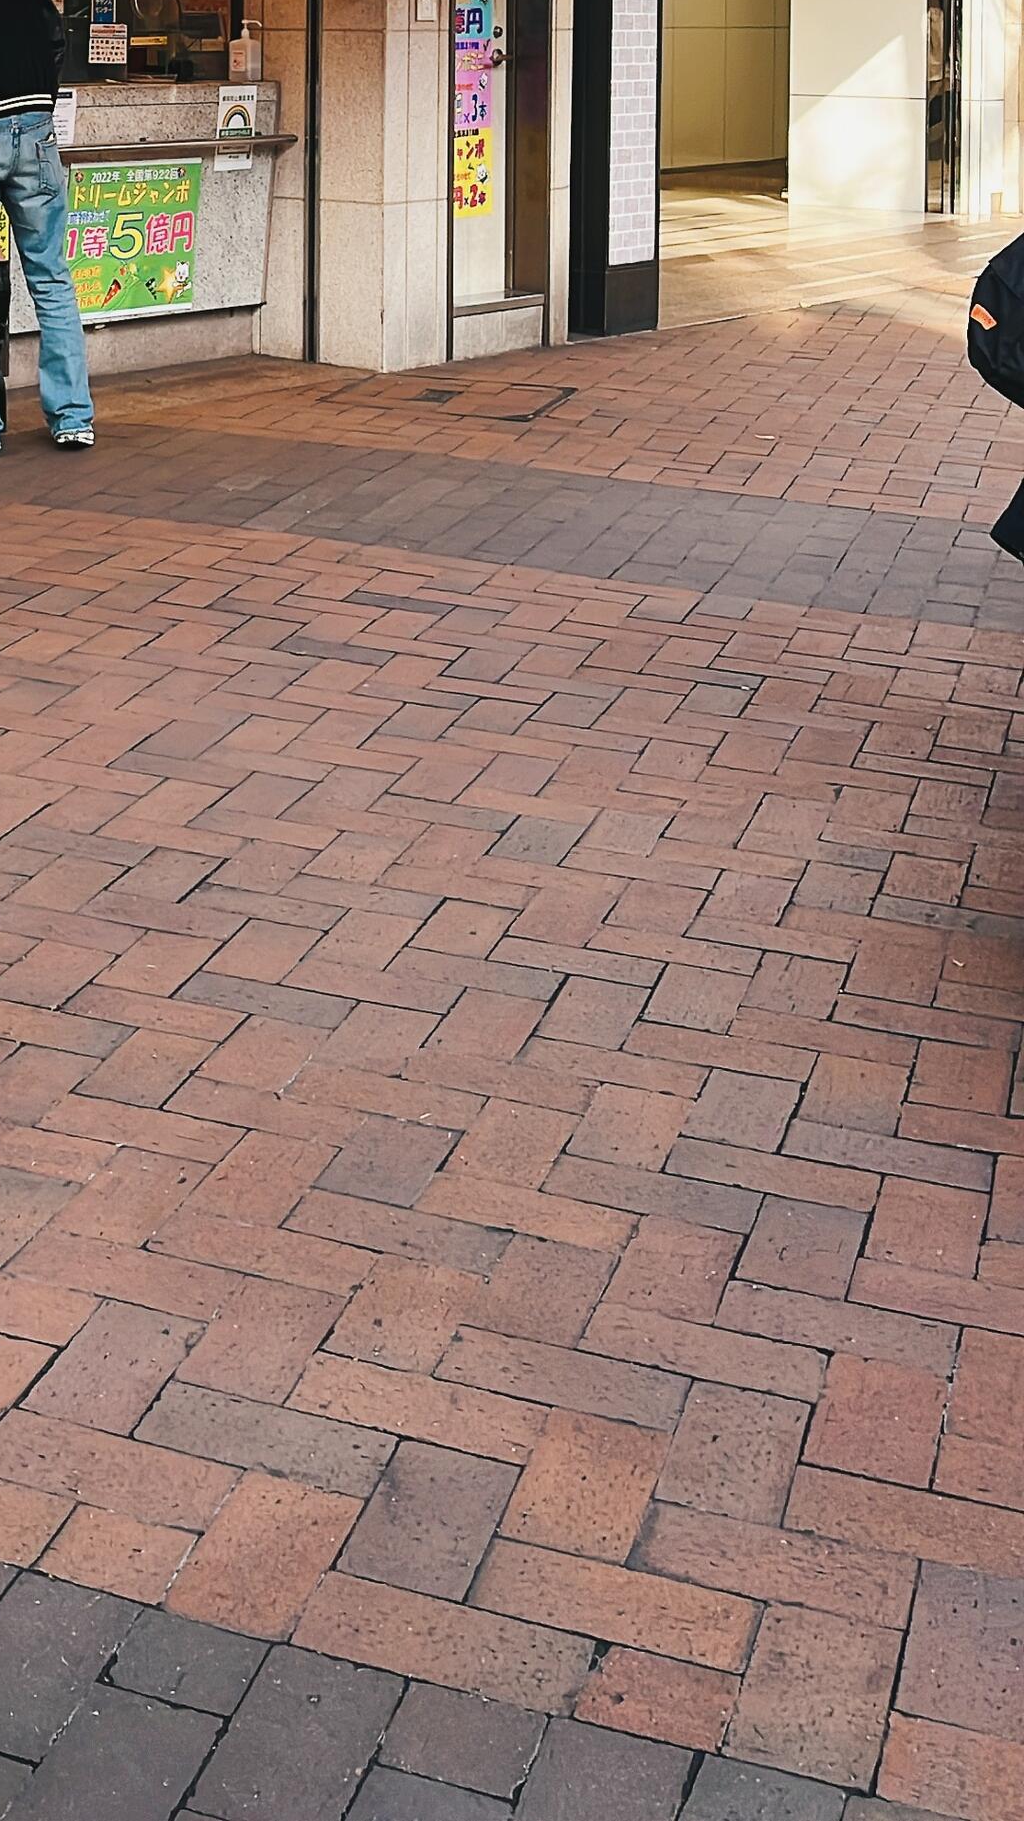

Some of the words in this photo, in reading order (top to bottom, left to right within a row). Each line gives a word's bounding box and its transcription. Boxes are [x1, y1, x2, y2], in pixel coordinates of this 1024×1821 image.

[91, 171, 121, 184] 2022年
[75, 180, 190, 210] ドリームジャンボ
